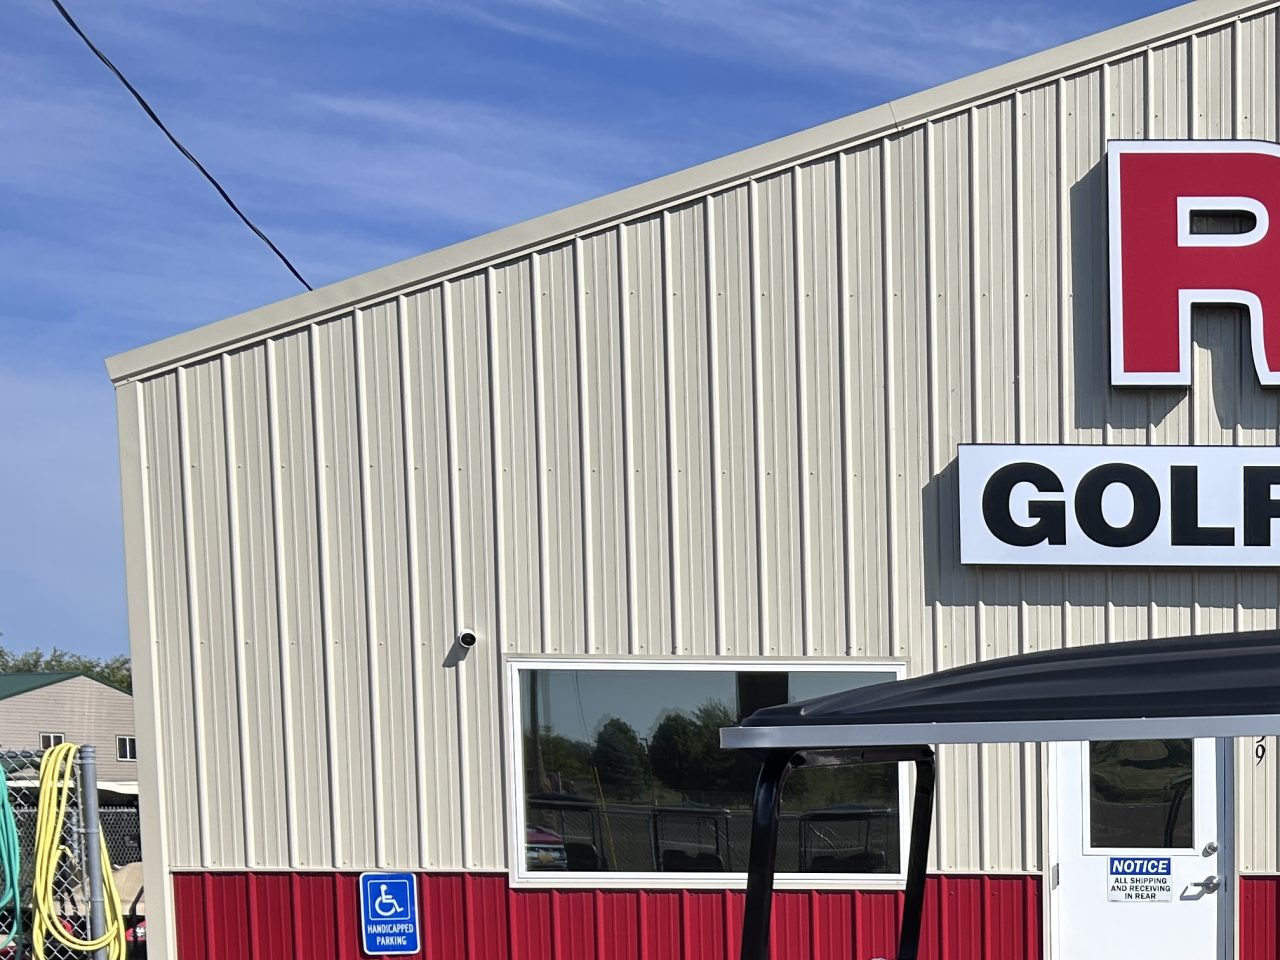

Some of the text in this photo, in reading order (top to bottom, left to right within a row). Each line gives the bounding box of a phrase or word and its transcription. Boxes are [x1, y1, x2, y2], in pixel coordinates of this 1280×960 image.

[1112, 860, 1169, 873] NOTICE
[1124, 892, 1156, 900] IN REAR
[367, 923, 414, 934] HANDICAPPED
[376, 936, 407, 946] PARKING
